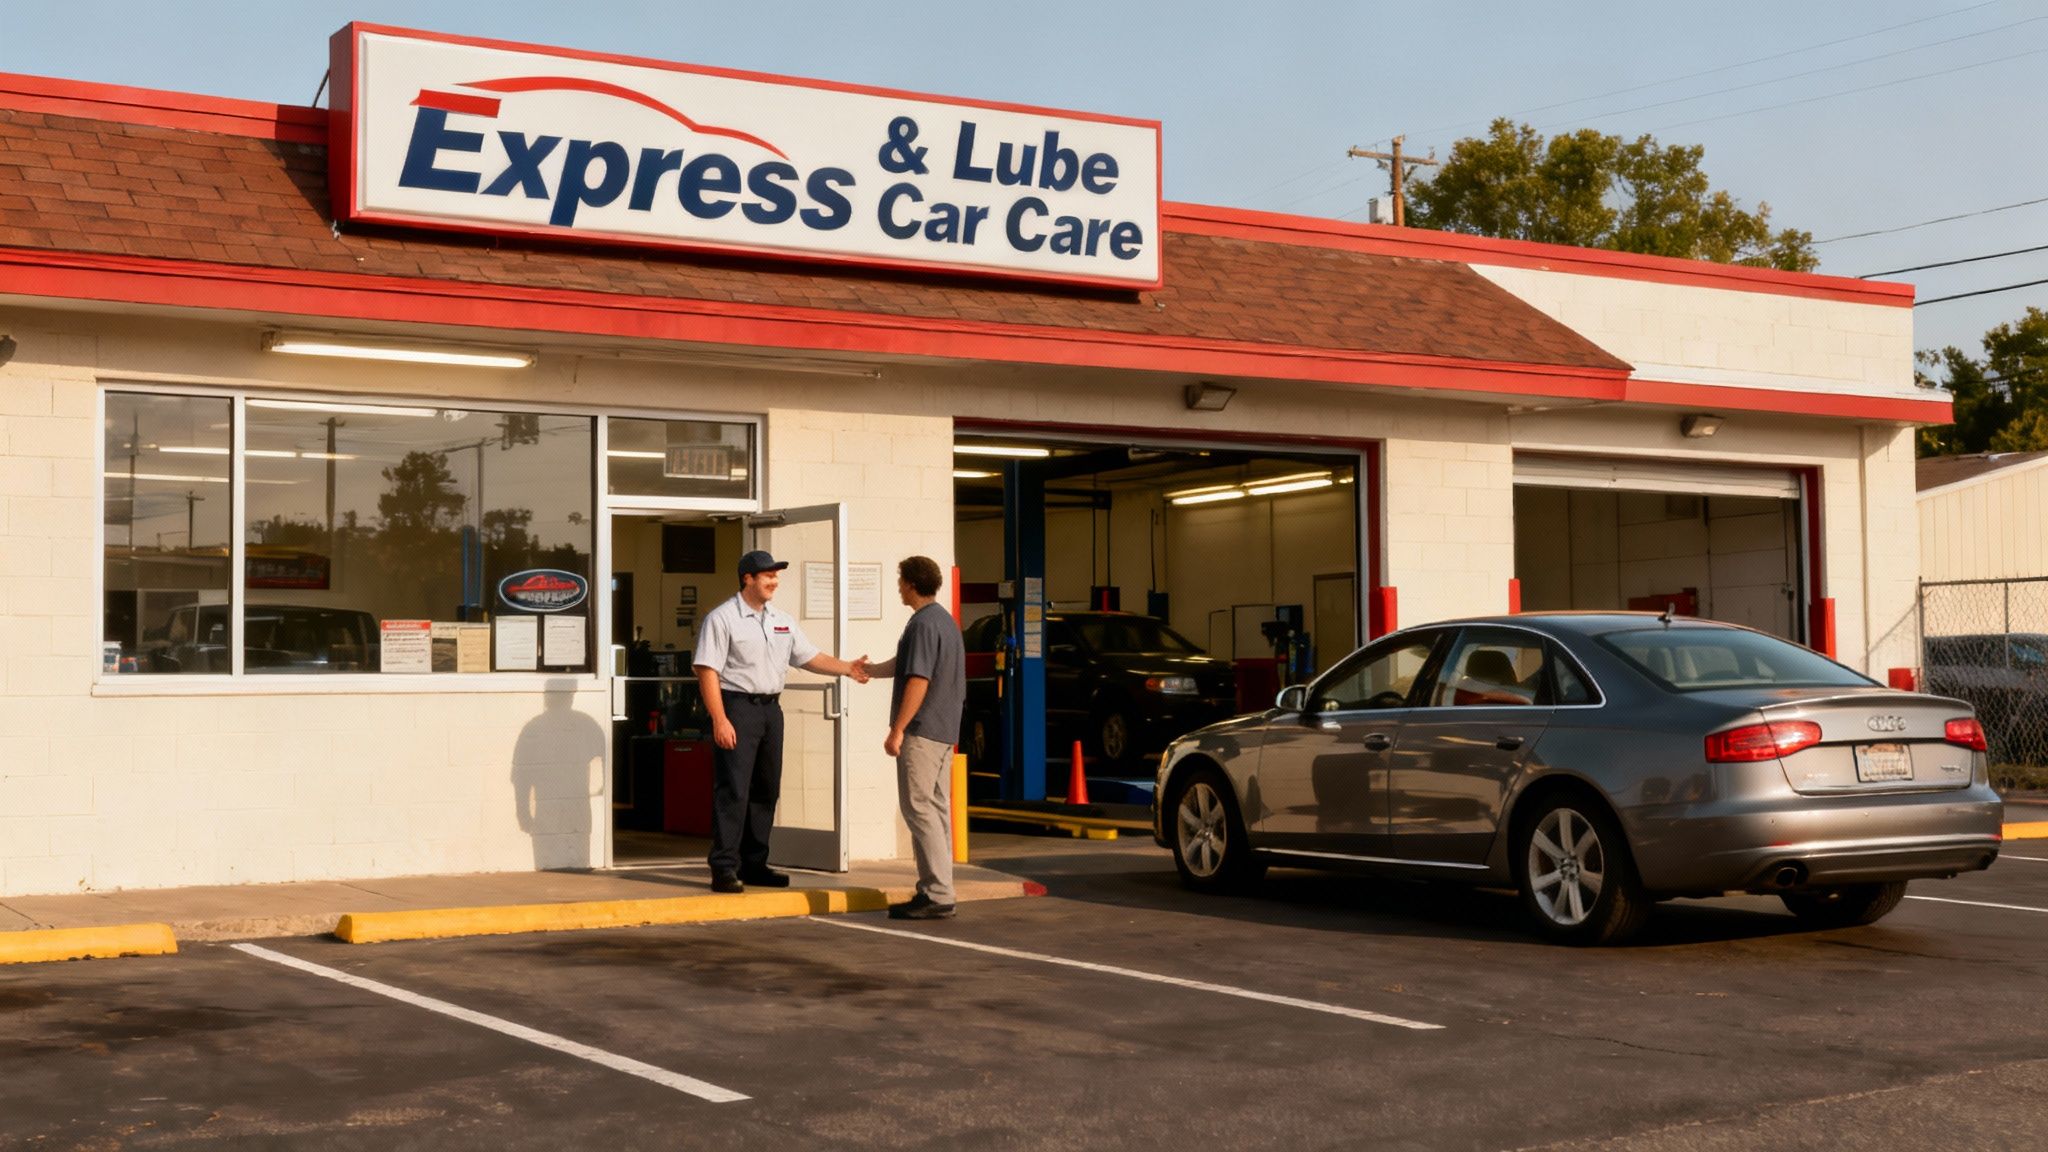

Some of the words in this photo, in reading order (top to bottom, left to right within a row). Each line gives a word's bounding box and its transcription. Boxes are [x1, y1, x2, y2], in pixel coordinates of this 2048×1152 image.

[399, 89, 855, 230] Express
[879, 116, 927, 175] &
[954, 122, 1119, 194] Lube
[878, 183, 989, 244] Car
[1007, 197, 1142, 259] Care
